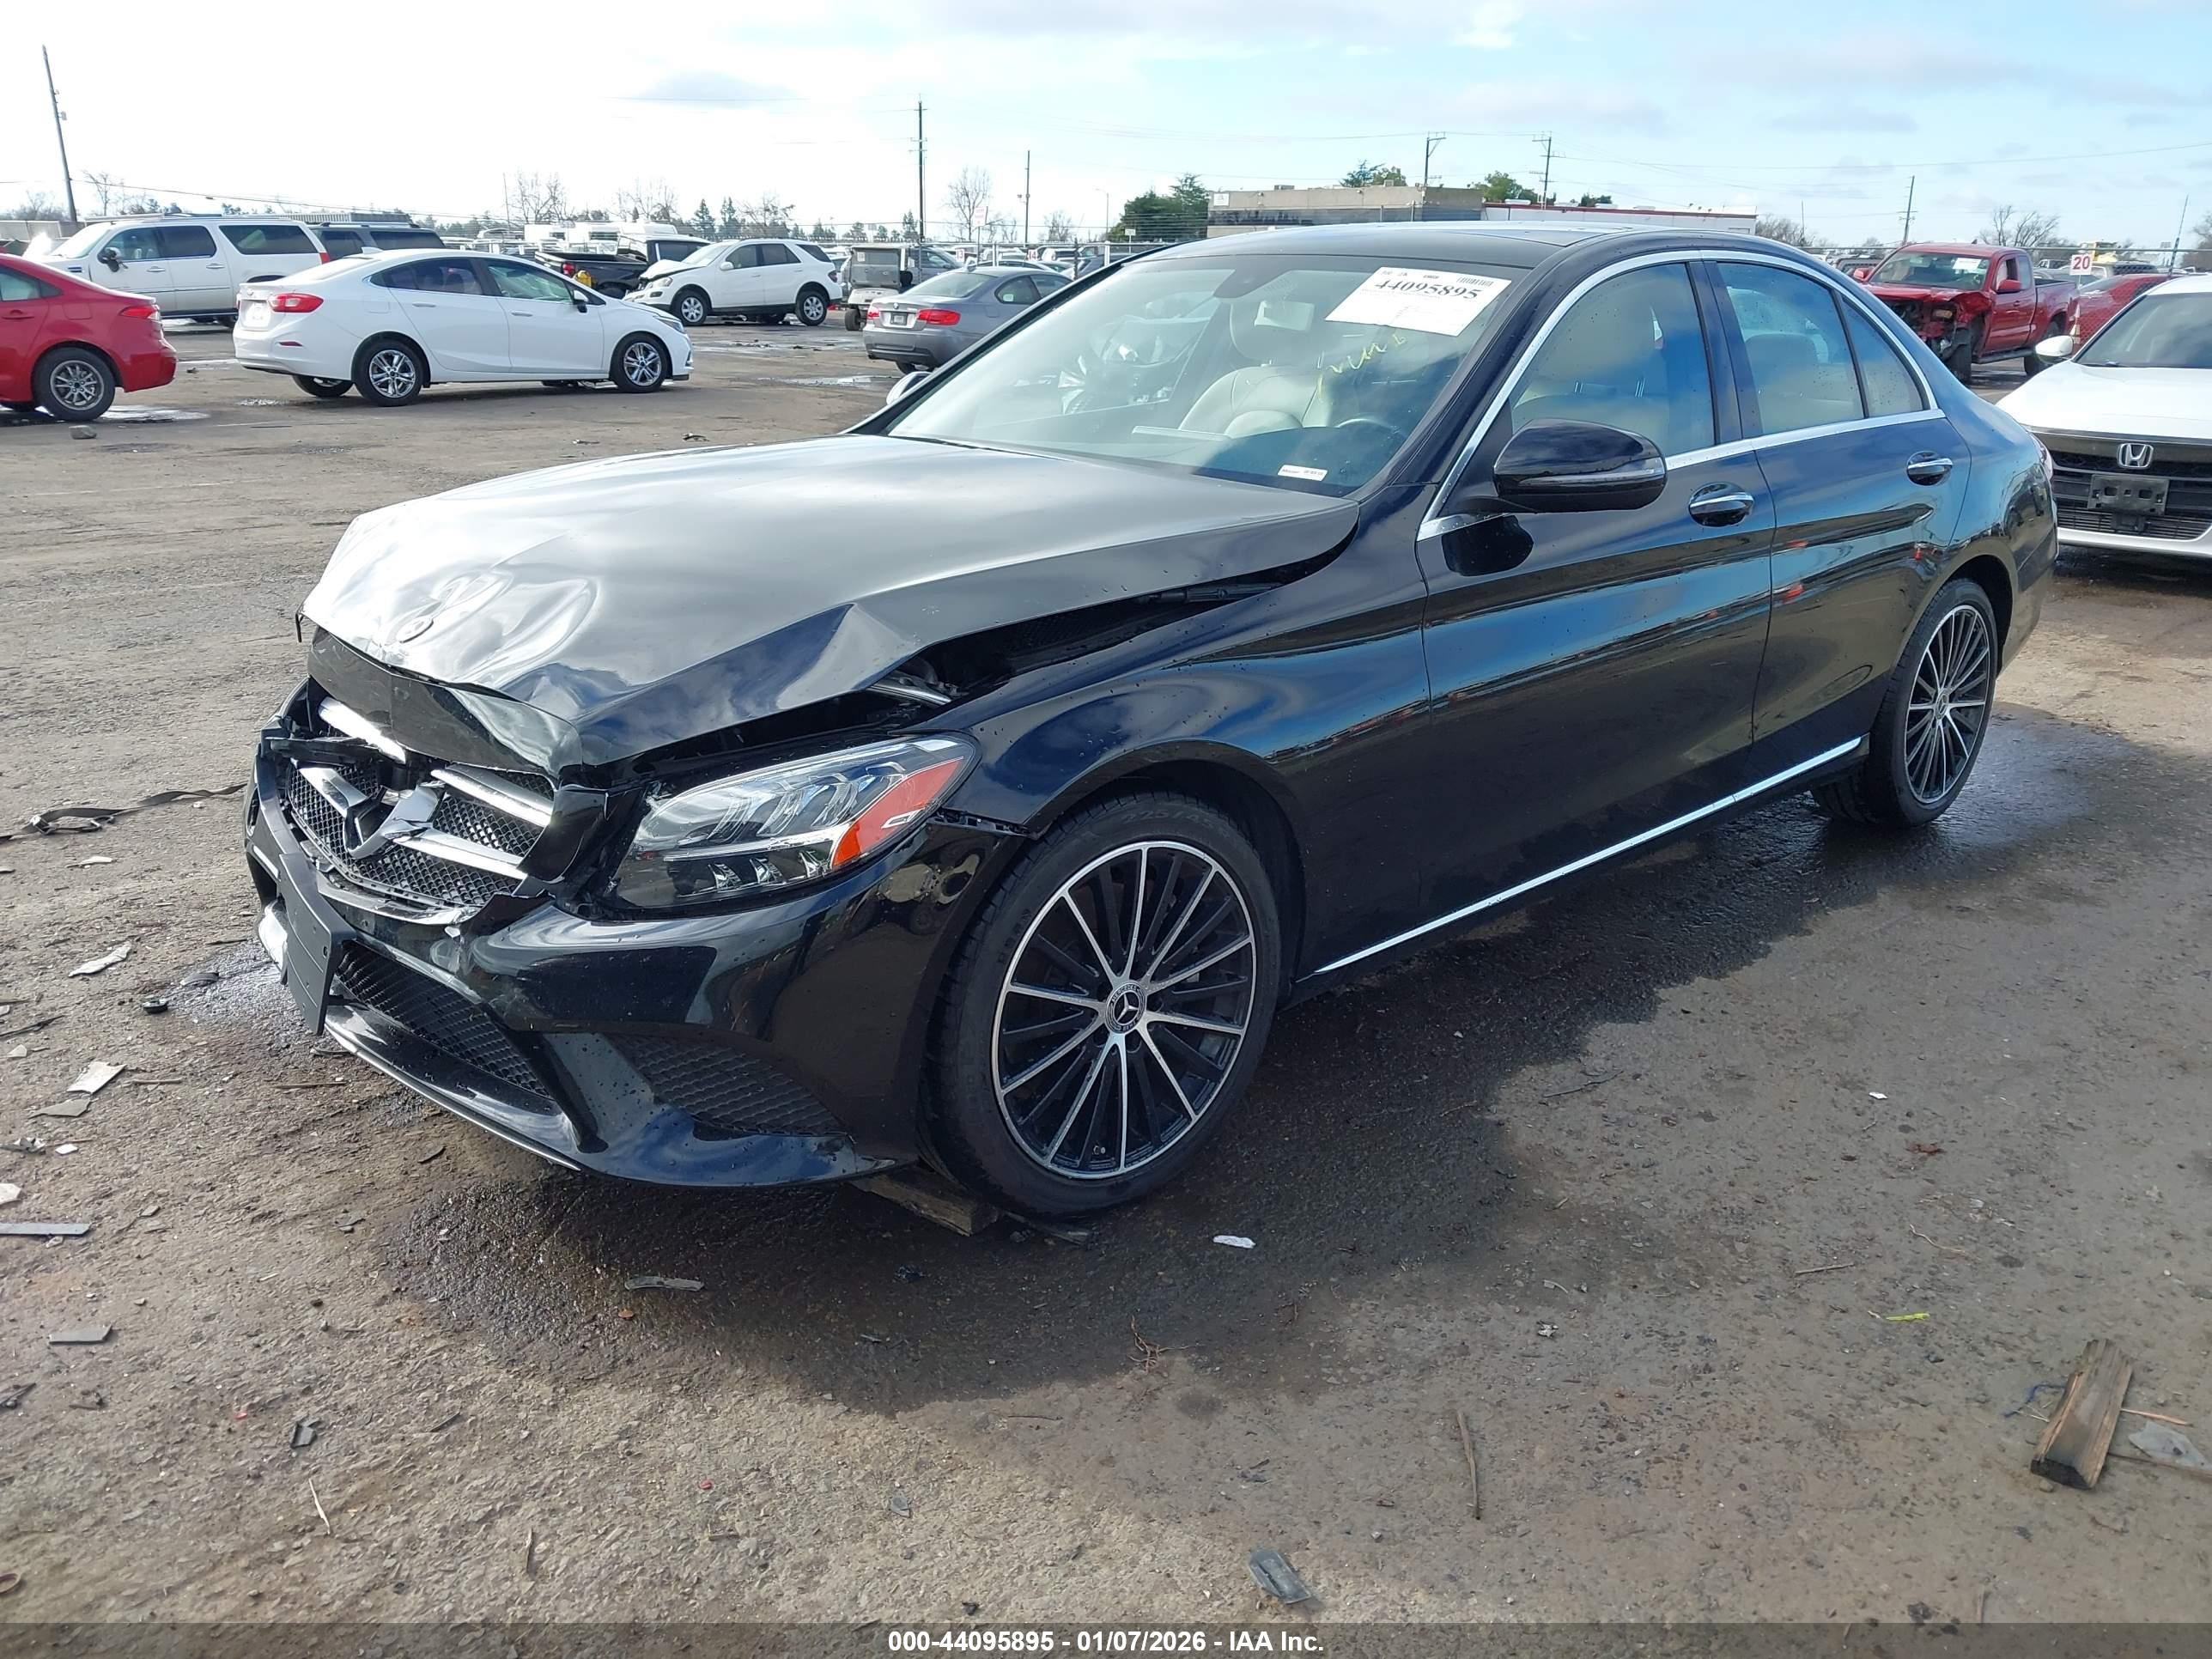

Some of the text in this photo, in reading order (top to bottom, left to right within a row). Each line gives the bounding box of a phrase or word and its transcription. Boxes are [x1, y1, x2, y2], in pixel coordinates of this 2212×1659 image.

[1029, 250, 1036, 260] 14
[2073, 256, 2091, 270] 20
[1374, 279, 1483, 300] 44095895
